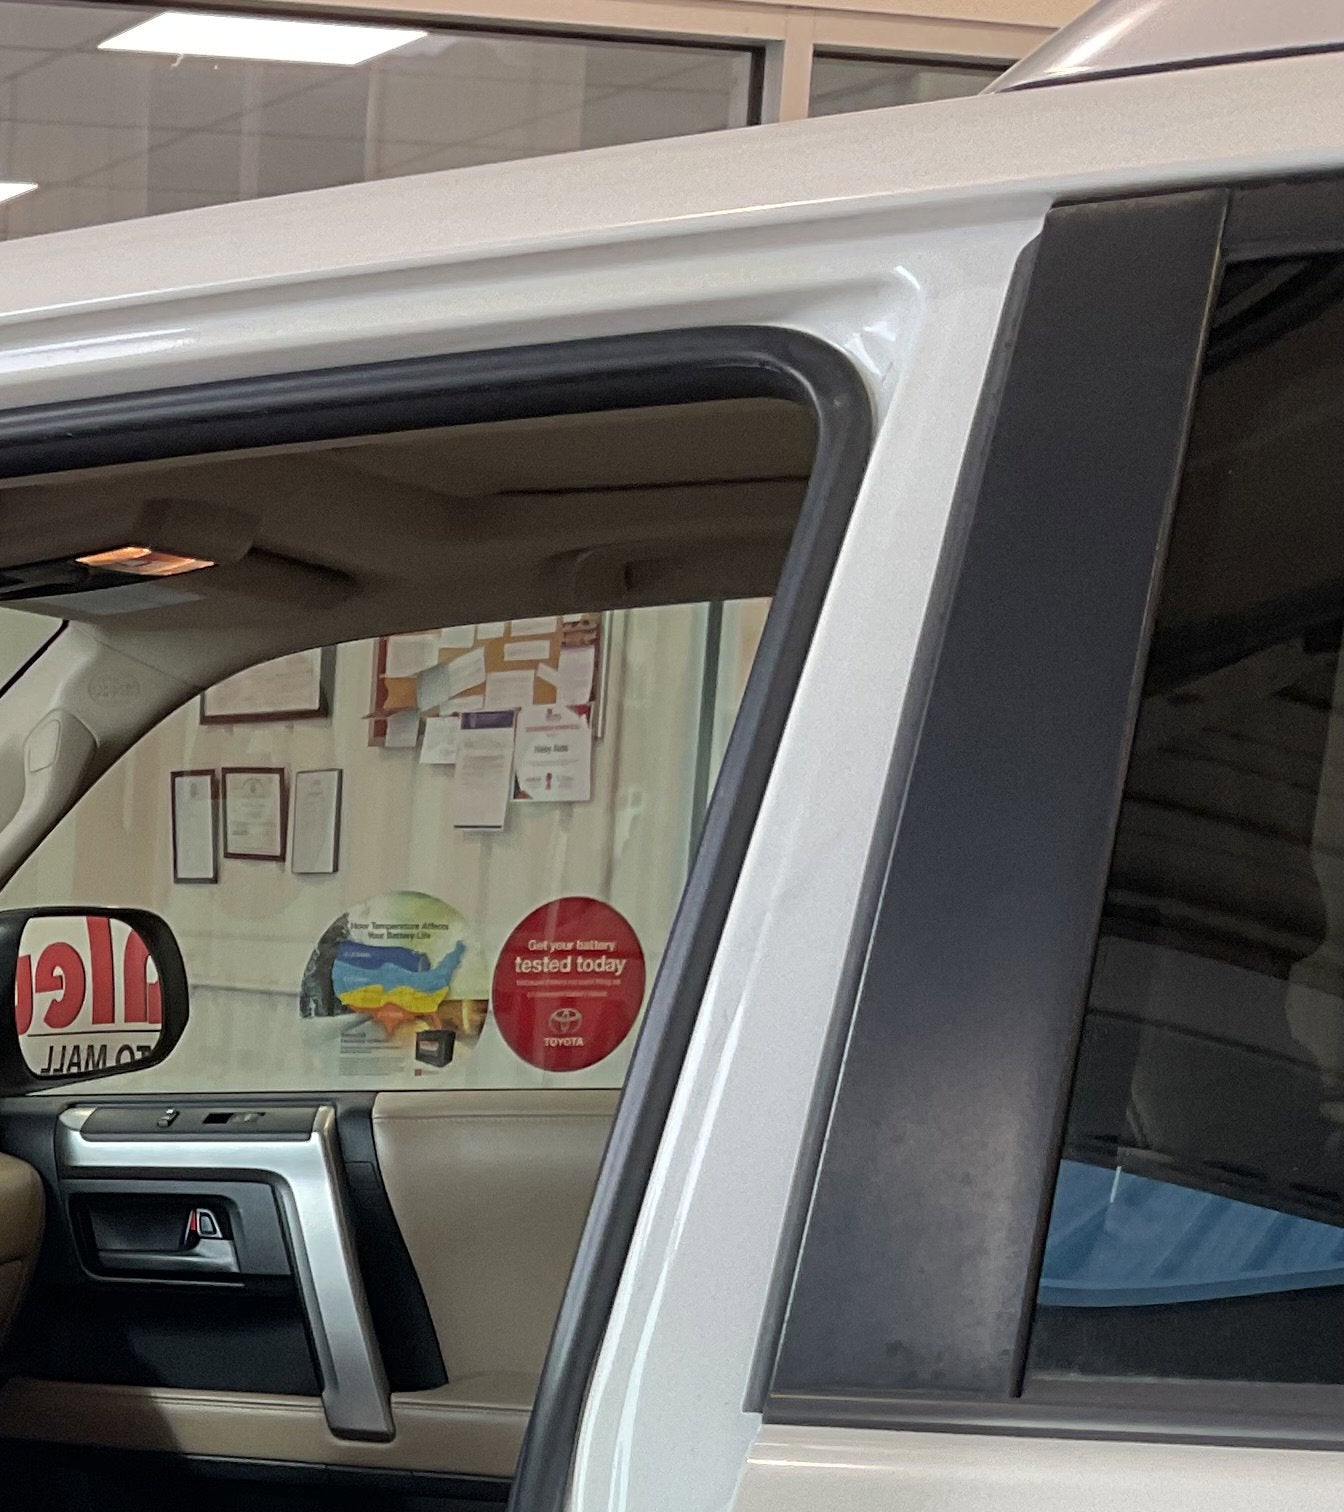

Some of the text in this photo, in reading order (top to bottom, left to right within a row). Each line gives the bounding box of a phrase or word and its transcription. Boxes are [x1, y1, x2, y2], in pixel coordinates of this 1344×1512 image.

[371, 922, 420, 931] Temperature
[386, 932, 415, 941] Battery
[528, 939, 616, 953] Get your battery
[515, 955, 627, 976] tested today
[544, 1037, 585, 1047] TOYOTA
